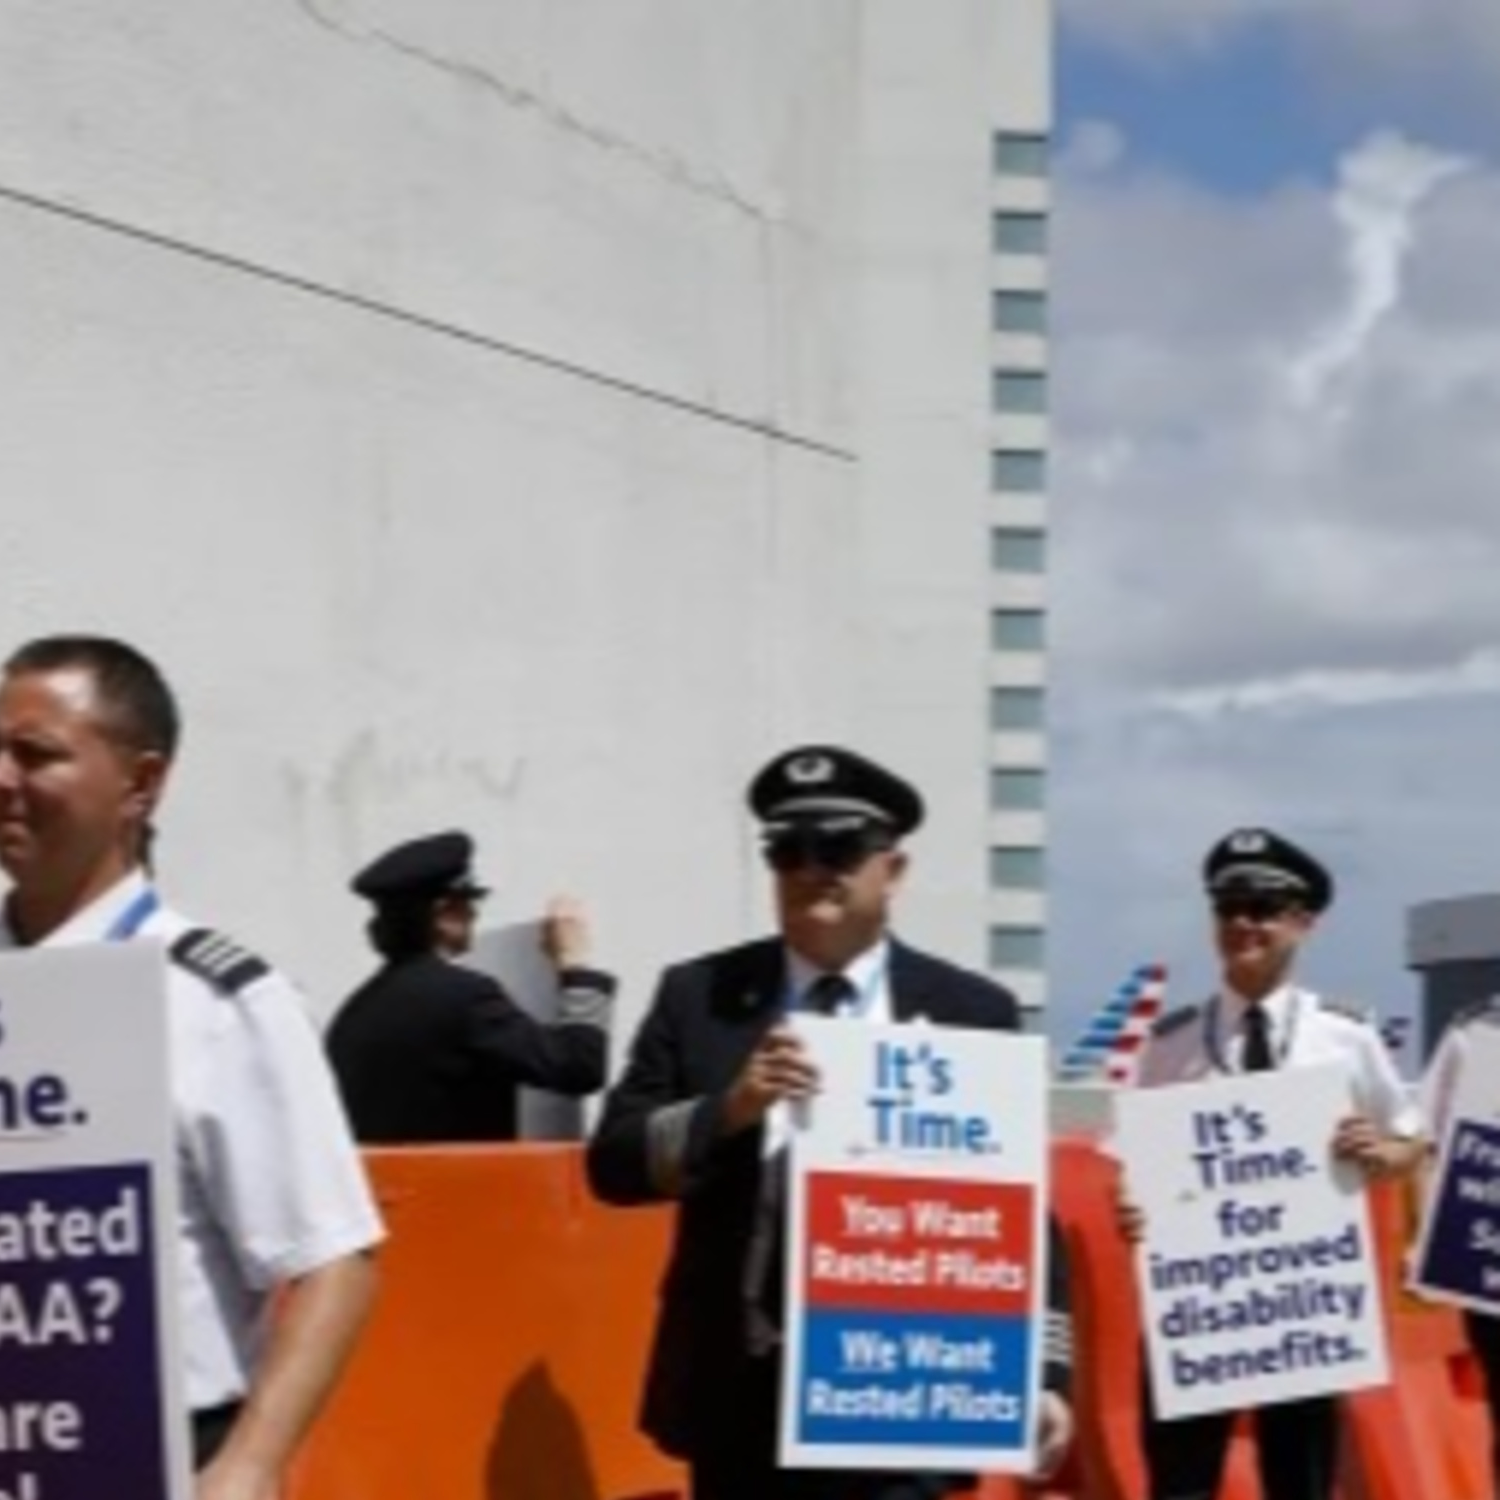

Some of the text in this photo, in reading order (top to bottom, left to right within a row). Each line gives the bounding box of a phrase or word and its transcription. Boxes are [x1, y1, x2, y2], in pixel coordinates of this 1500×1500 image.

[876, 1040, 951, 1094] It's
[868, 1098, 1002, 1154] Time.
[1192, 1105, 1266, 1146] It's
[841, 1195, 1002, 1239] You Want
[1217, 1201, 1284, 1238] for
[812, 1245, 1025, 1292] Rested Pilots
[1148, 1225, 1360, 1291] improved
[1159, 1281, 1366, 1338] disability
[839, 1330, 994, 1371] We Want
[1171, 1331, 1366, 1388] benefits.
[807, 1377, 1020, 1421] Rested Pilots
